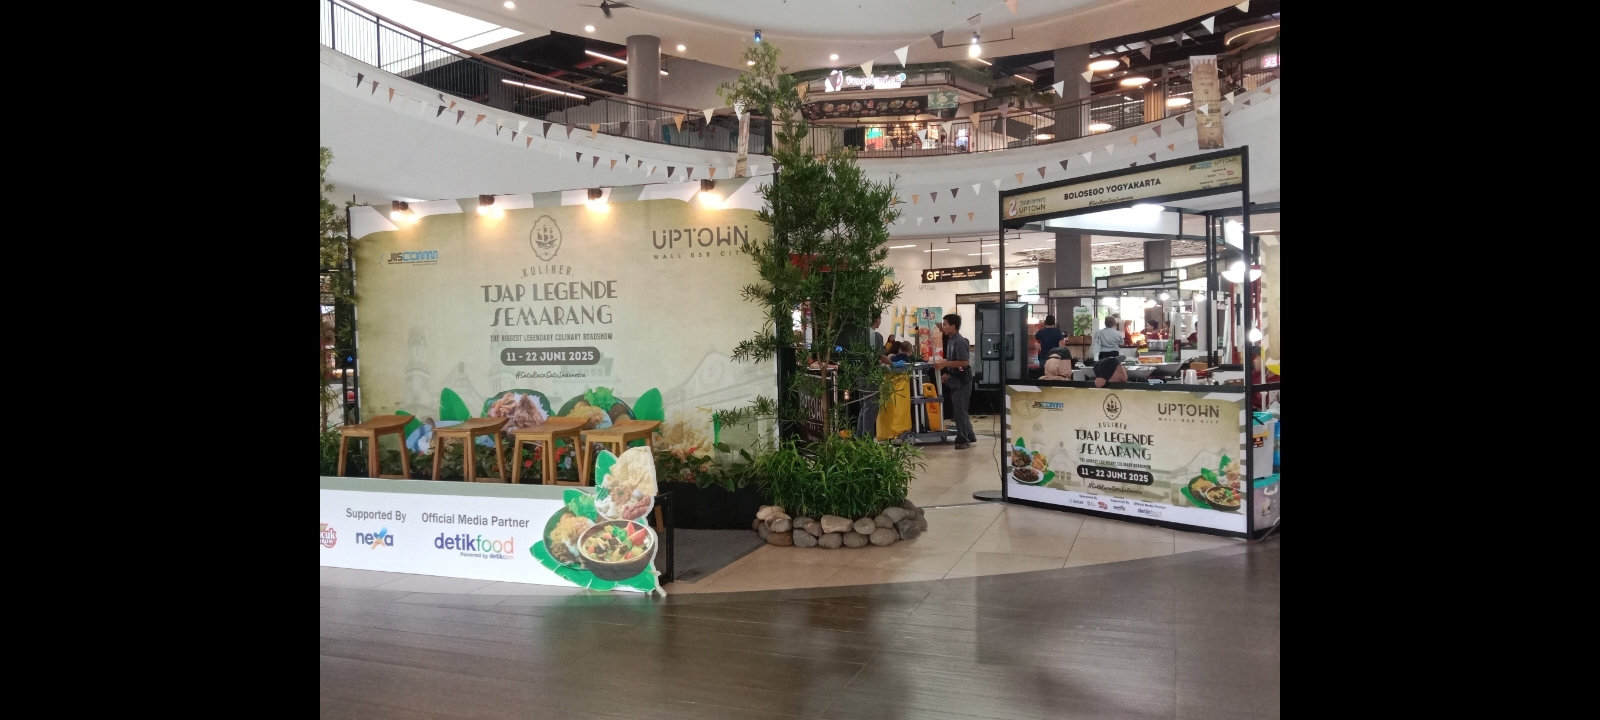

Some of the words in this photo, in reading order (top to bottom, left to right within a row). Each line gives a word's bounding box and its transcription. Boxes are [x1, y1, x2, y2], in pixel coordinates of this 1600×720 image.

[1064, 187, 1105, 200] BOLOSEGO
[1106, 178, 1161, 193] YOGYAKARTA
[1019, 204, 1046, 214] UPTOWN
[652, 225, 749, 250] UPTOWN
[926, 271, 940, 280] GF
[481, 284, 525, 303] TJAP
[532, 280, 618, 301] LEGENDE
[490, 304, 613, 327] SEMARANG
[490, 335, 500, 343] THE
[501, 334, 522, 342] BIGGEST
[524, 334, 553, 342] LEGENDARY
[555, 333, 581, 341] CULINARY
[506, 352, 516, 362] 11
[525, 352, 538, 362] 22
[540, 351, 566, 361] JUNI
[568, 351, 594, 361] 2025
[1158, 403, 1219, 418] UPTOWN
[1074, 429, 1101, 441] TJAP
[1104, 431, 1155, 446] LEGENDE
[1080, 443, 1152, 461] SEMARANG
[1081, 468, 1089, 476] 11
[1096, 469, 1105, 478] 22
[1106, 471, 1127, 480] JUNI
[1128, 473, 1149, 482] 2025
[345, 507, 393, 521] Supported
[395, 510, 407, 523] By
[421, 512, 455, 525] Official
[457, 514, 488, 527] Media
[491, 515, 530, 529] Partner
[434, 532, 515, 555] detikfood
